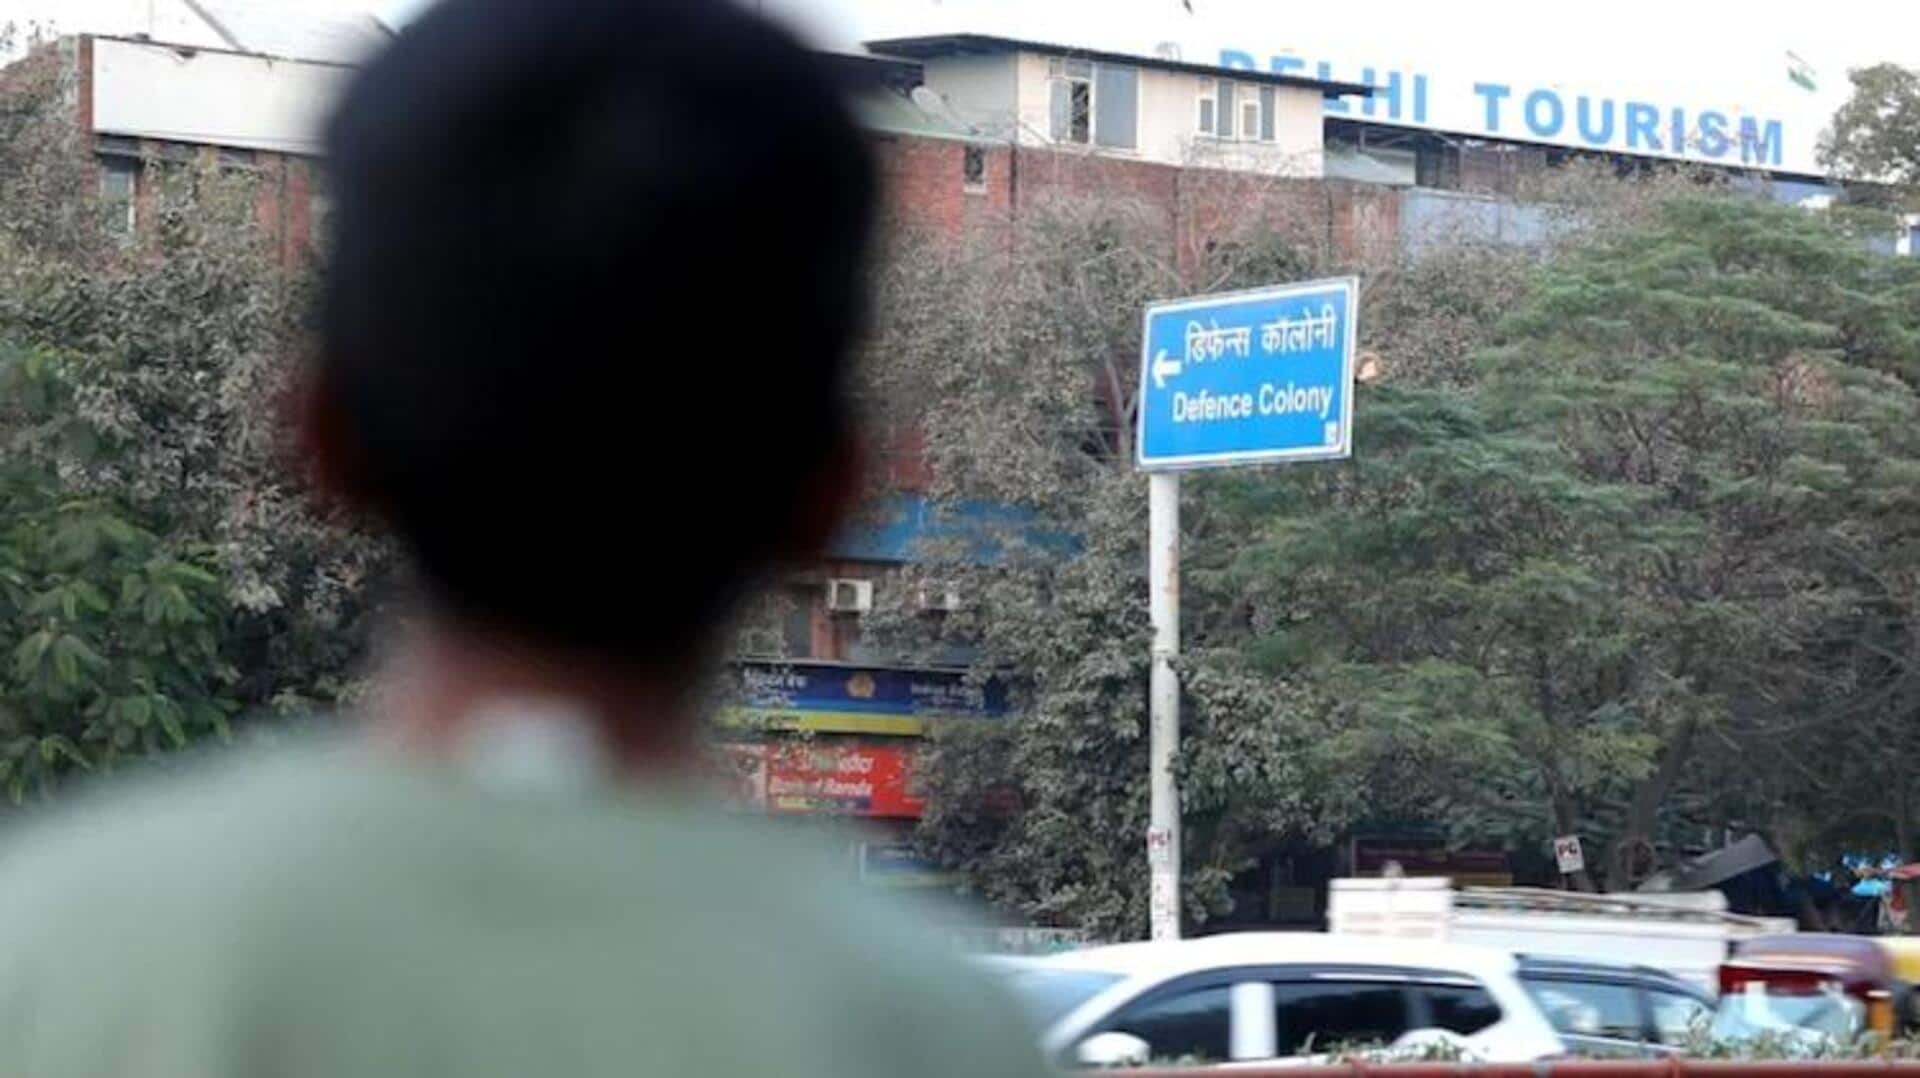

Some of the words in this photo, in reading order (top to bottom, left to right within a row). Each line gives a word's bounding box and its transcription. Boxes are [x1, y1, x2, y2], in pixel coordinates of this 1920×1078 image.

[1473, 82, 1783, 165] TOURISM
[1185, 317, 1251, 364] डिफेन्स
[1262, 304, 1335, 355] कॉलोनी
[1172, 388, 1253, 423] Defence
[1258, 382, 1333, 419] Colony
